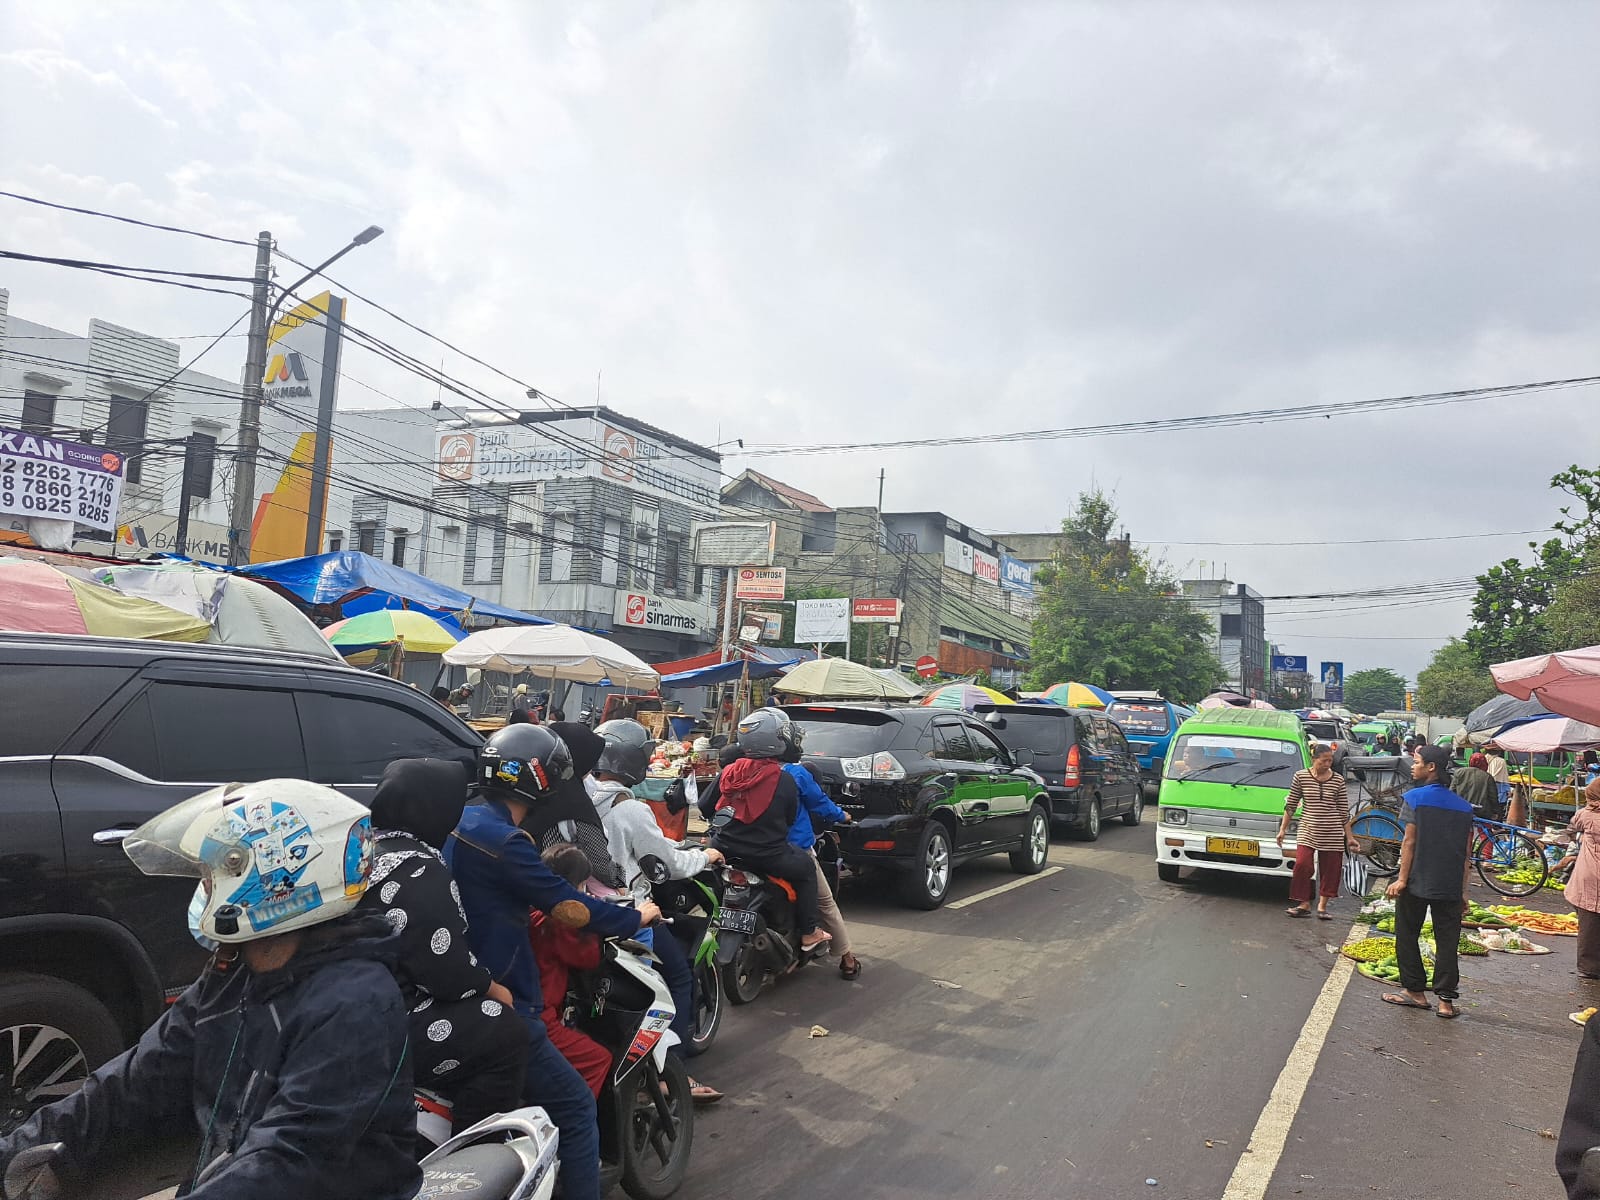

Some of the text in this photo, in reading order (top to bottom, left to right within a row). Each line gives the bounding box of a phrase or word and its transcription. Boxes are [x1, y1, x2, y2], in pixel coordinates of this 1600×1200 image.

[479, 432, 508, 446] bank
[479, 448, 587, 475] sinarmas
[23, 461, 71, 482] 8262
[77, 471, 114, 492] 7776
[22, 478, 72, 498] 7860
[78, 487, 112, 508] 2119
[22, 495, 72, 514] 0825
[78, 502, 109, 524] 8285
[755, 570, 782, 579] SENTOSA
[975, 554, 998, 581] Rinnai
[647, 598, 662, 608] bank
[646, 609, 696, 629] sinarmas
[1223, 840, 1240, 849] 1974
